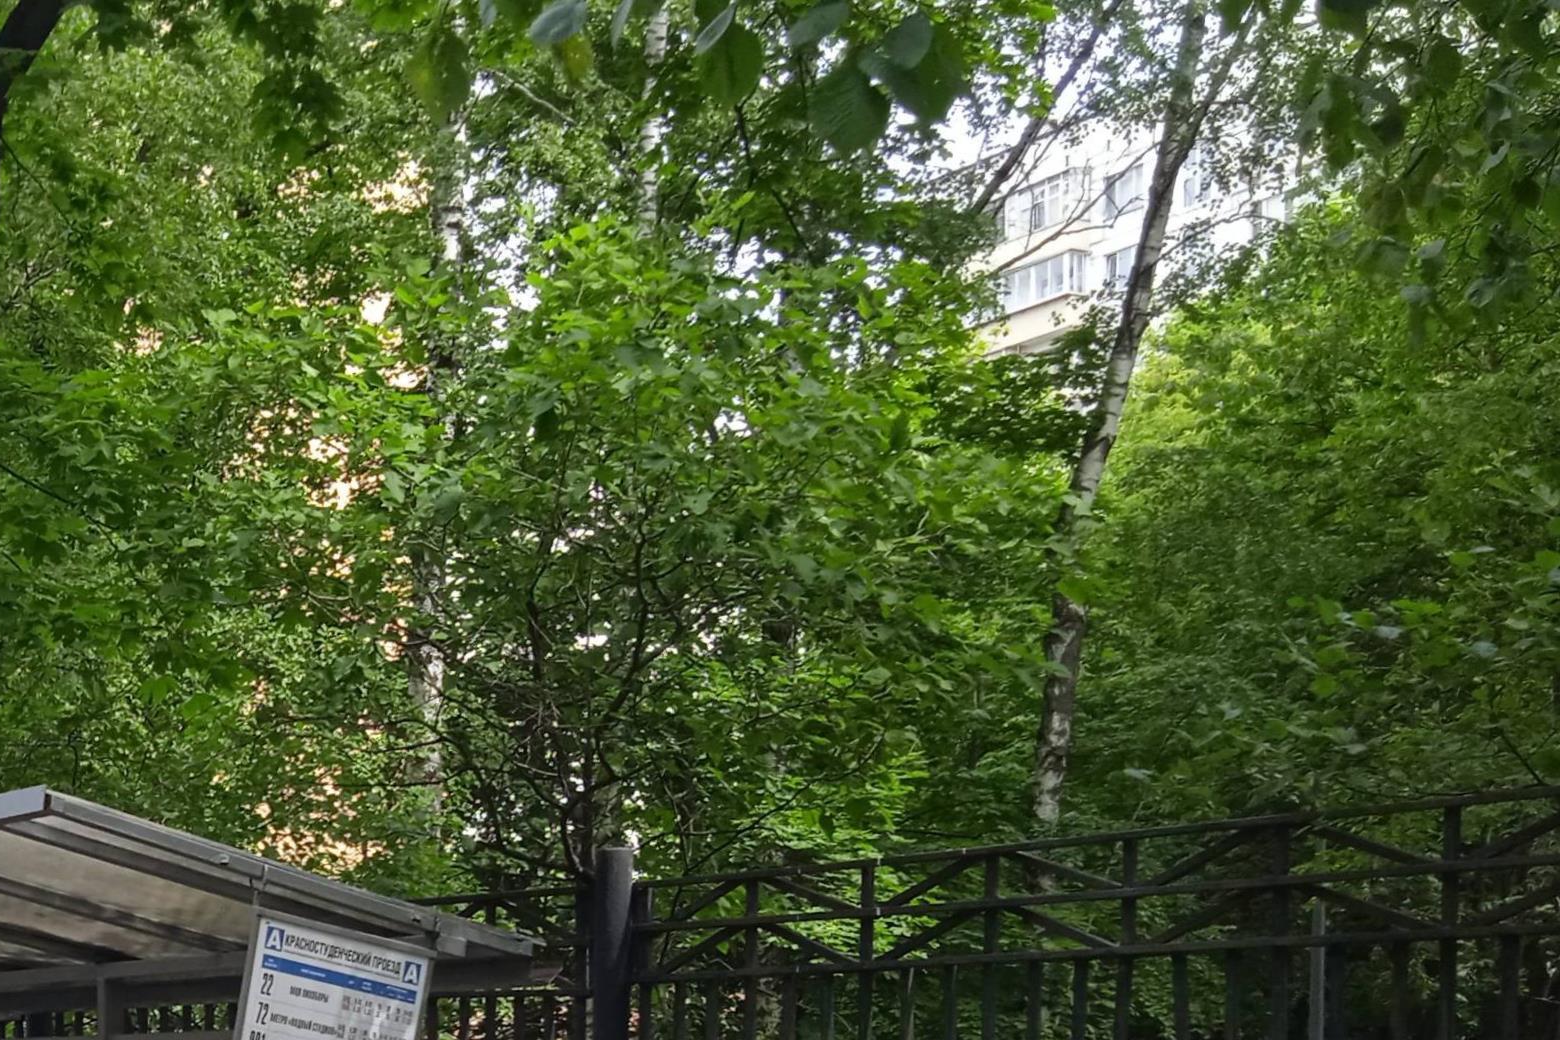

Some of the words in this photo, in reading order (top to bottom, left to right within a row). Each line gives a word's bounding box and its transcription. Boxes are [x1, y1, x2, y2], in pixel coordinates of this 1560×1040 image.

[285, 935, 371, 963] КРАСНОСТУДЕНЧЕСКИЙ
[372, 955, 401, 976] ПРОЕЗД
[260, 973, 274, 996] 22
[256, 1001, 269, 1025] 72
